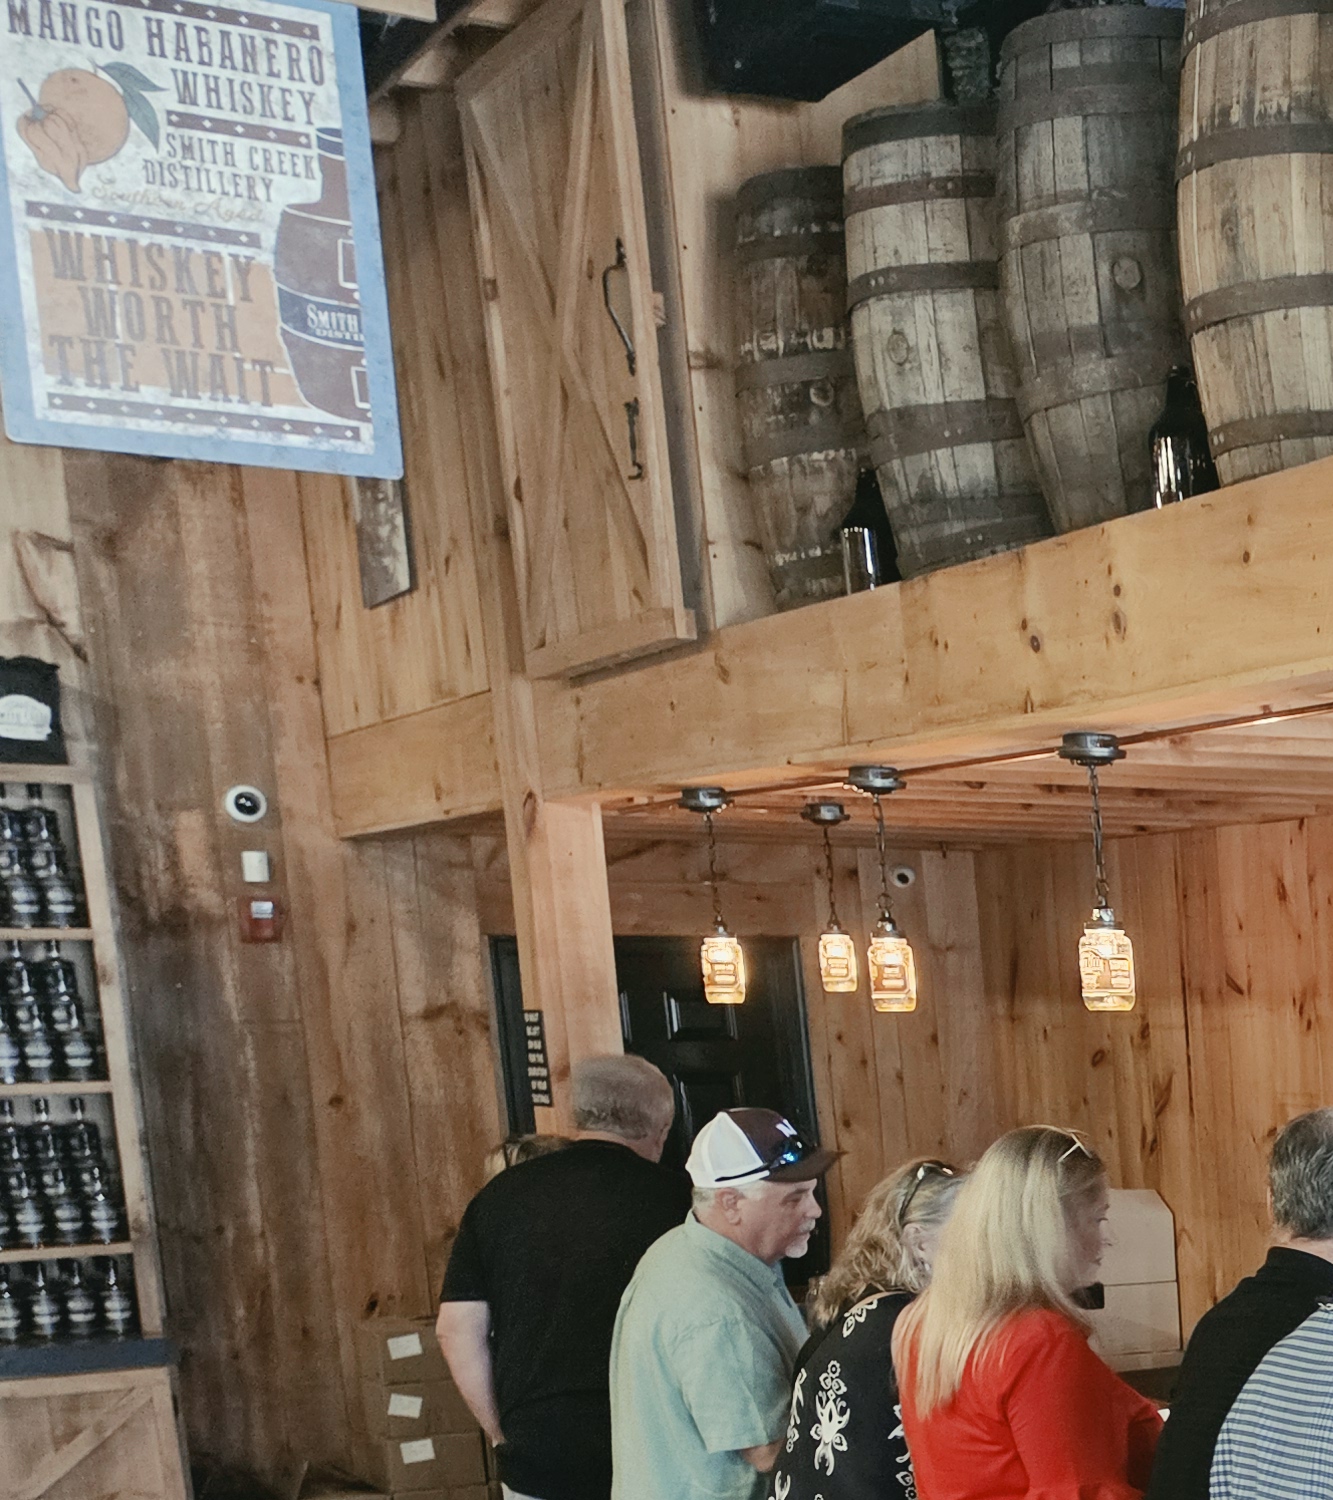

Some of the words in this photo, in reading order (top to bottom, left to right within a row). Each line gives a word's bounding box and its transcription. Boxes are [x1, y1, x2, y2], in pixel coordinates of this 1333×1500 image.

[5, 0, 124, 52] MANGO
[143, 16, 326, 87] HABANERO
[170, 67, 317, 126] WHISKEY
[142, 158, 274, 203] DISTILLERY
[165, 132, 238, 168] SMITH
[249, 147, 317, 181] CREEK
[43, 227, 257, 303] WHISKEY
[78, 285, 242, 356] WORTH
[49, 334, 141, 392] THE
[160, 348, 275, 408] WAIT
